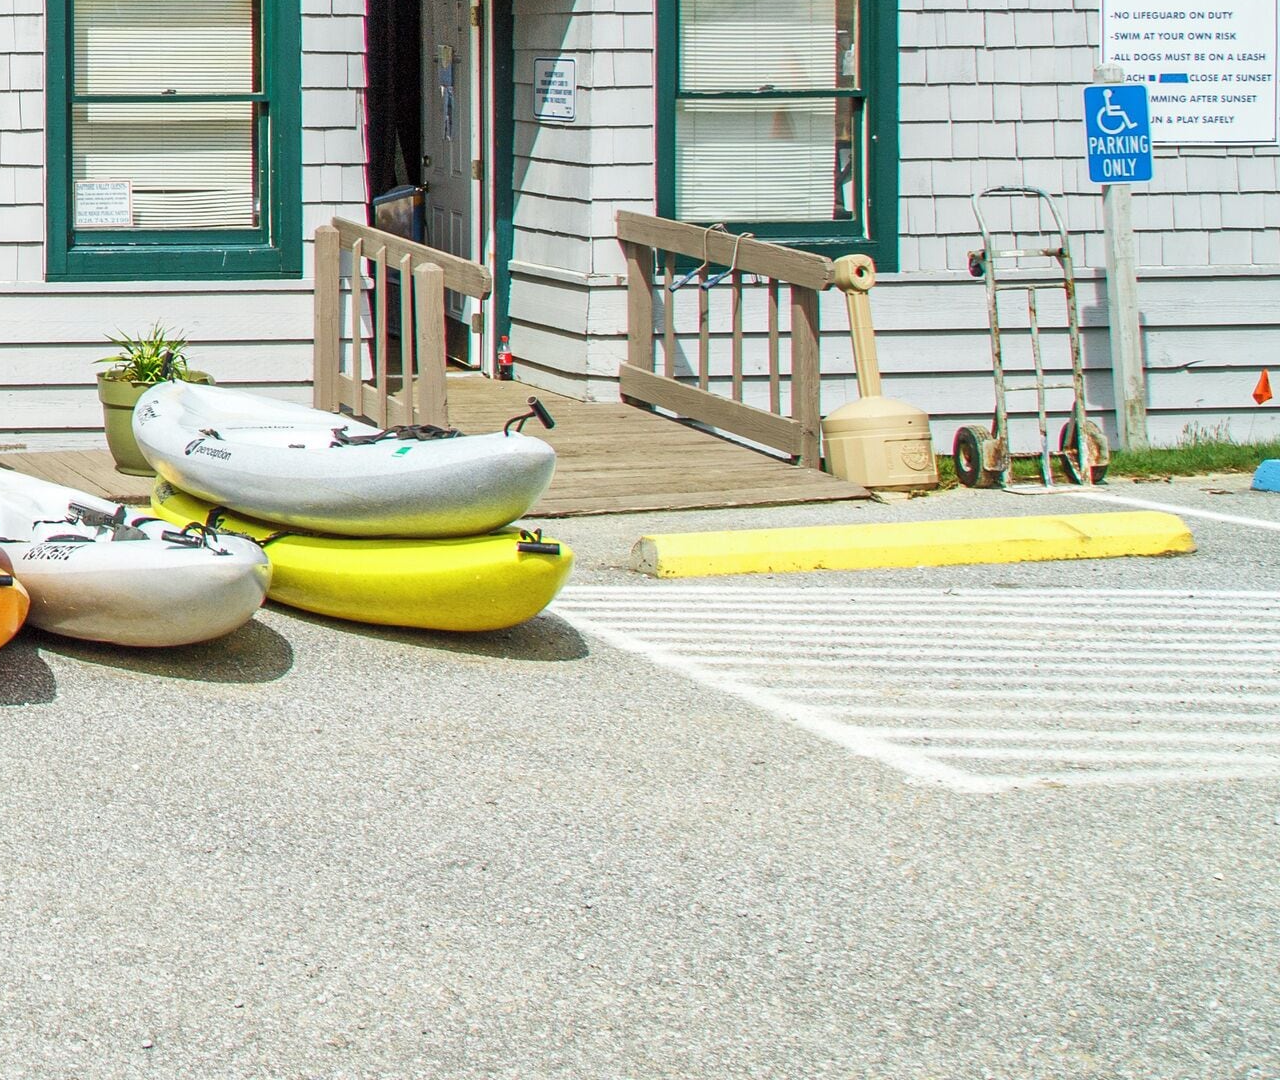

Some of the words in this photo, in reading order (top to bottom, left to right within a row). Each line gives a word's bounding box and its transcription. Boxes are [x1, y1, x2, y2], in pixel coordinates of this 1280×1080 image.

[1133, 11, 1186, 20] LIFEGUARD
[1189, 11, 1205, 20] ON
[1208, 11, 1234, 20] DUTY
[1143, 32, 1155, 41] AT
[1158, 32, 1184, 41] YOUR
[1188, 32, 1212, 41] OWN
[1215, 32, 1237, 41] RISK
[1134, 52, 1162, 62] DOGS
[1164, 52, 1191, 62] MUST
[1194, 52, 1206, 62] BE
[1209, 52, 1224, 62] ON
[1227, 52, 1234, 62] A
[1237, 53, 1266, 62] LEASH
[1189, 74, 1219, 83] CLOSE
[1221, 74, 1233, 83] AT
[1235, 74, 1272, 83] SUNSET
[1190, 95, 1218, 103] AFTER
[1221, 95, 1257, 103] SUNSET
[1166, 116, 1173, 124] &
[1176, 116, 1199, 124] PLAY
[1202, 116, 1234, 124] SAFELY
[1089, 135, 1149, 156] PARKING
[1103, 159, 1137, 177] ONLY
[195, 443, 232, 462] perception
